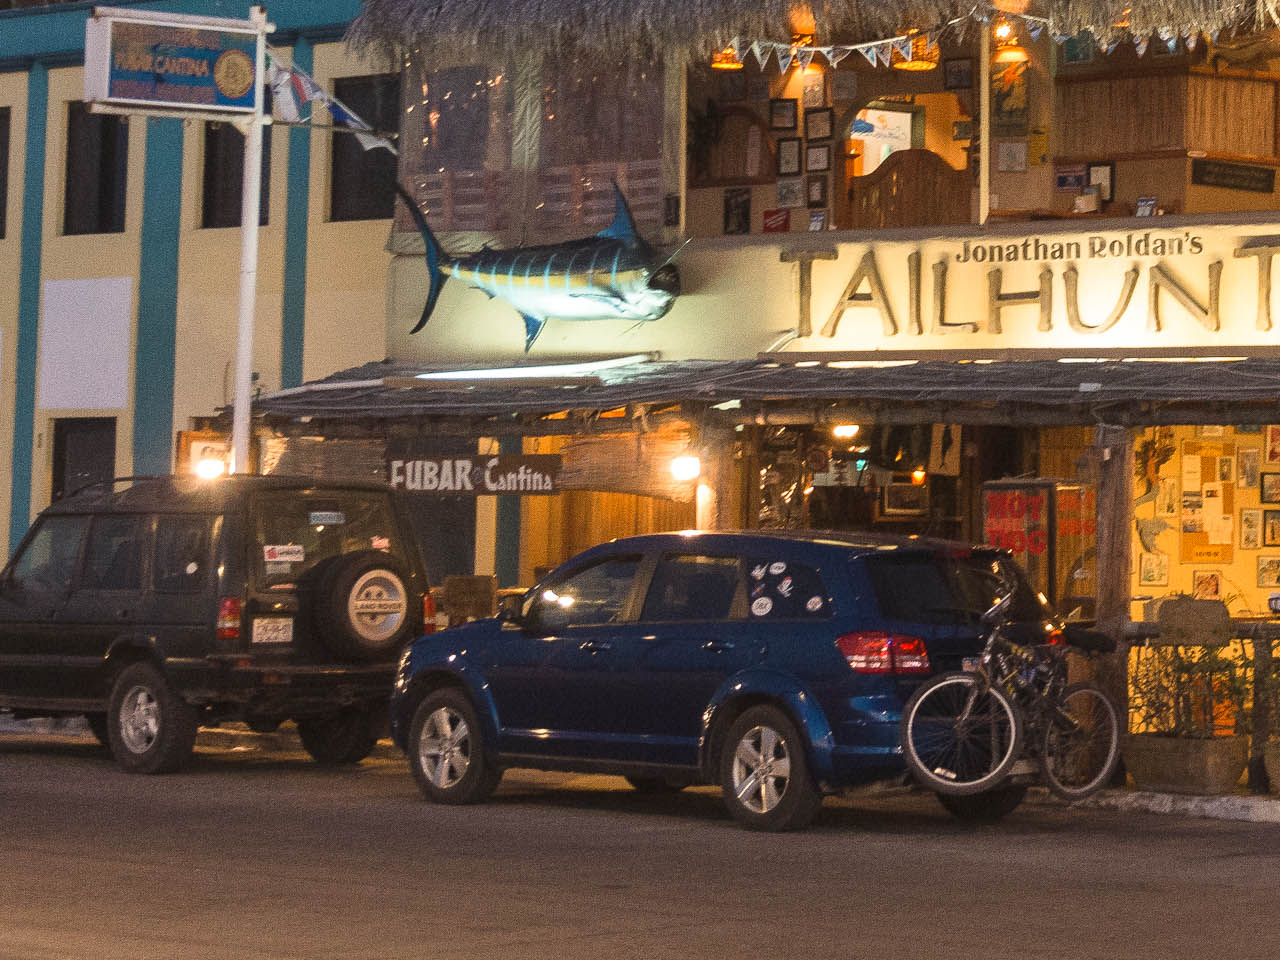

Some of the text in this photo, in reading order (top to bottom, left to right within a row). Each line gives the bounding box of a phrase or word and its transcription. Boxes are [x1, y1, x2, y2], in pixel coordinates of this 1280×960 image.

[153, 55, 209, 77] CANTINA
[955, 232, 1203, 264] Jonathan Roldan's
[391, 457, 553, 491] FUBAR Cantina
[985, 492, 1044, 519] HOT
[986, 530, 1046, 555] DOG
